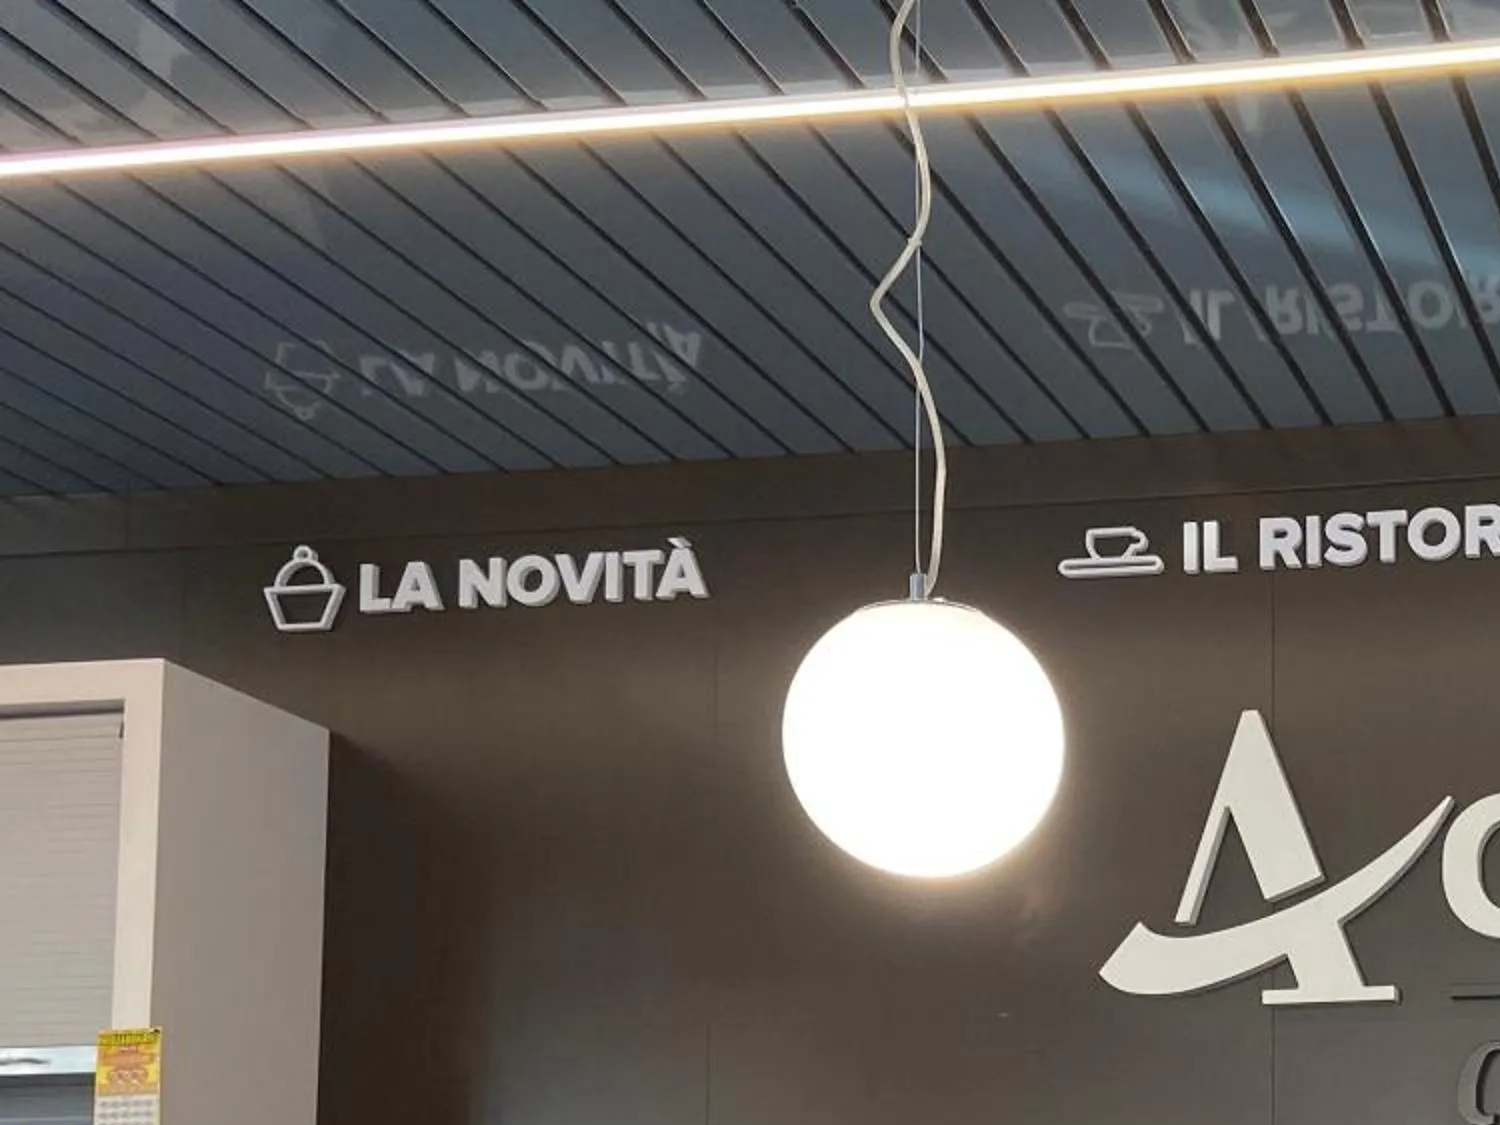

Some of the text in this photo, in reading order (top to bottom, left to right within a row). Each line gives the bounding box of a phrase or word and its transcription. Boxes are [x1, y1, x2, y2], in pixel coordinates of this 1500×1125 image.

[359, 536, 710, 613] LA NOVITÀ
[1183, 520, 1239, 575] IL
